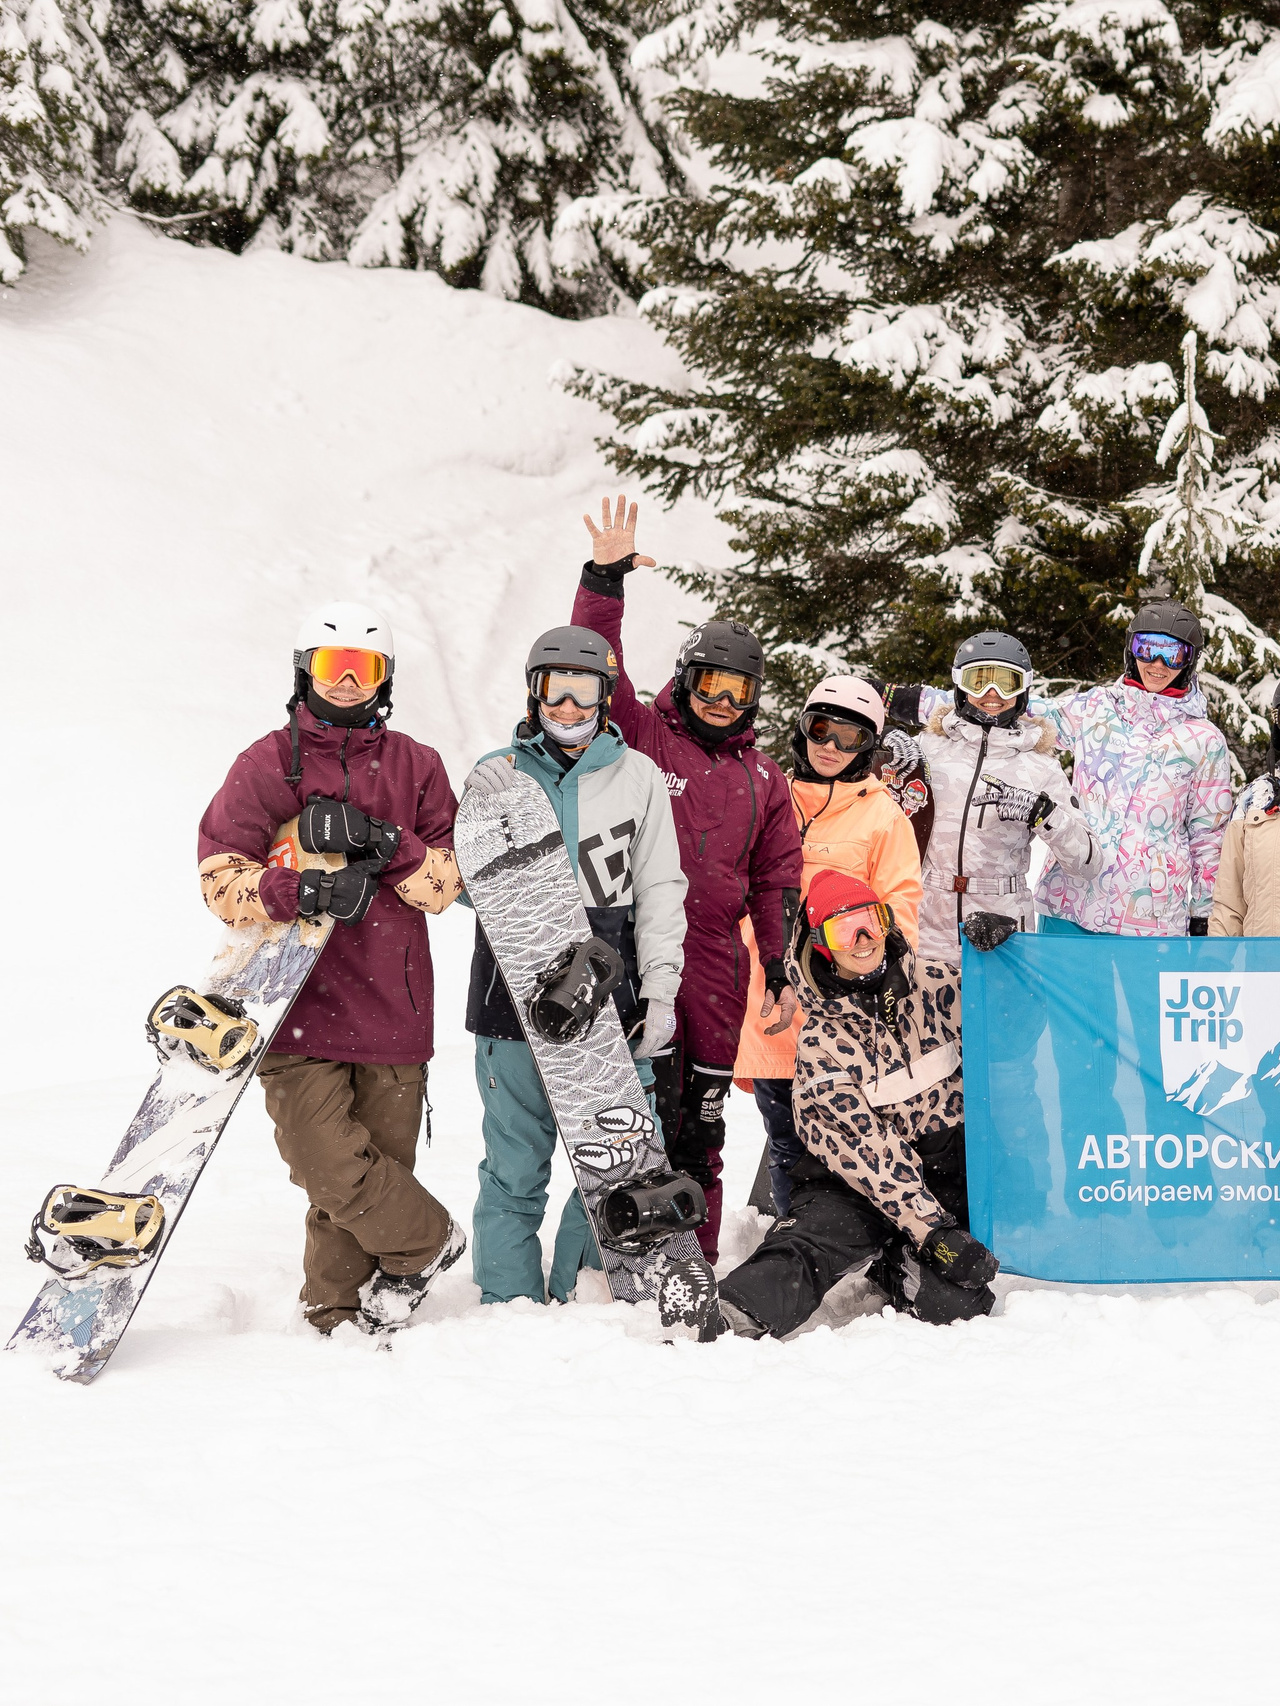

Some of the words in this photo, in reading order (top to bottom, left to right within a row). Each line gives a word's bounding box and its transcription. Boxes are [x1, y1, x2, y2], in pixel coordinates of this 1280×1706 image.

[1165, 978, 1241, 1018] Joy
[1165, 1010, 1244, 1050] Trip
[1078, 1179, 1213, 1207] собираем
